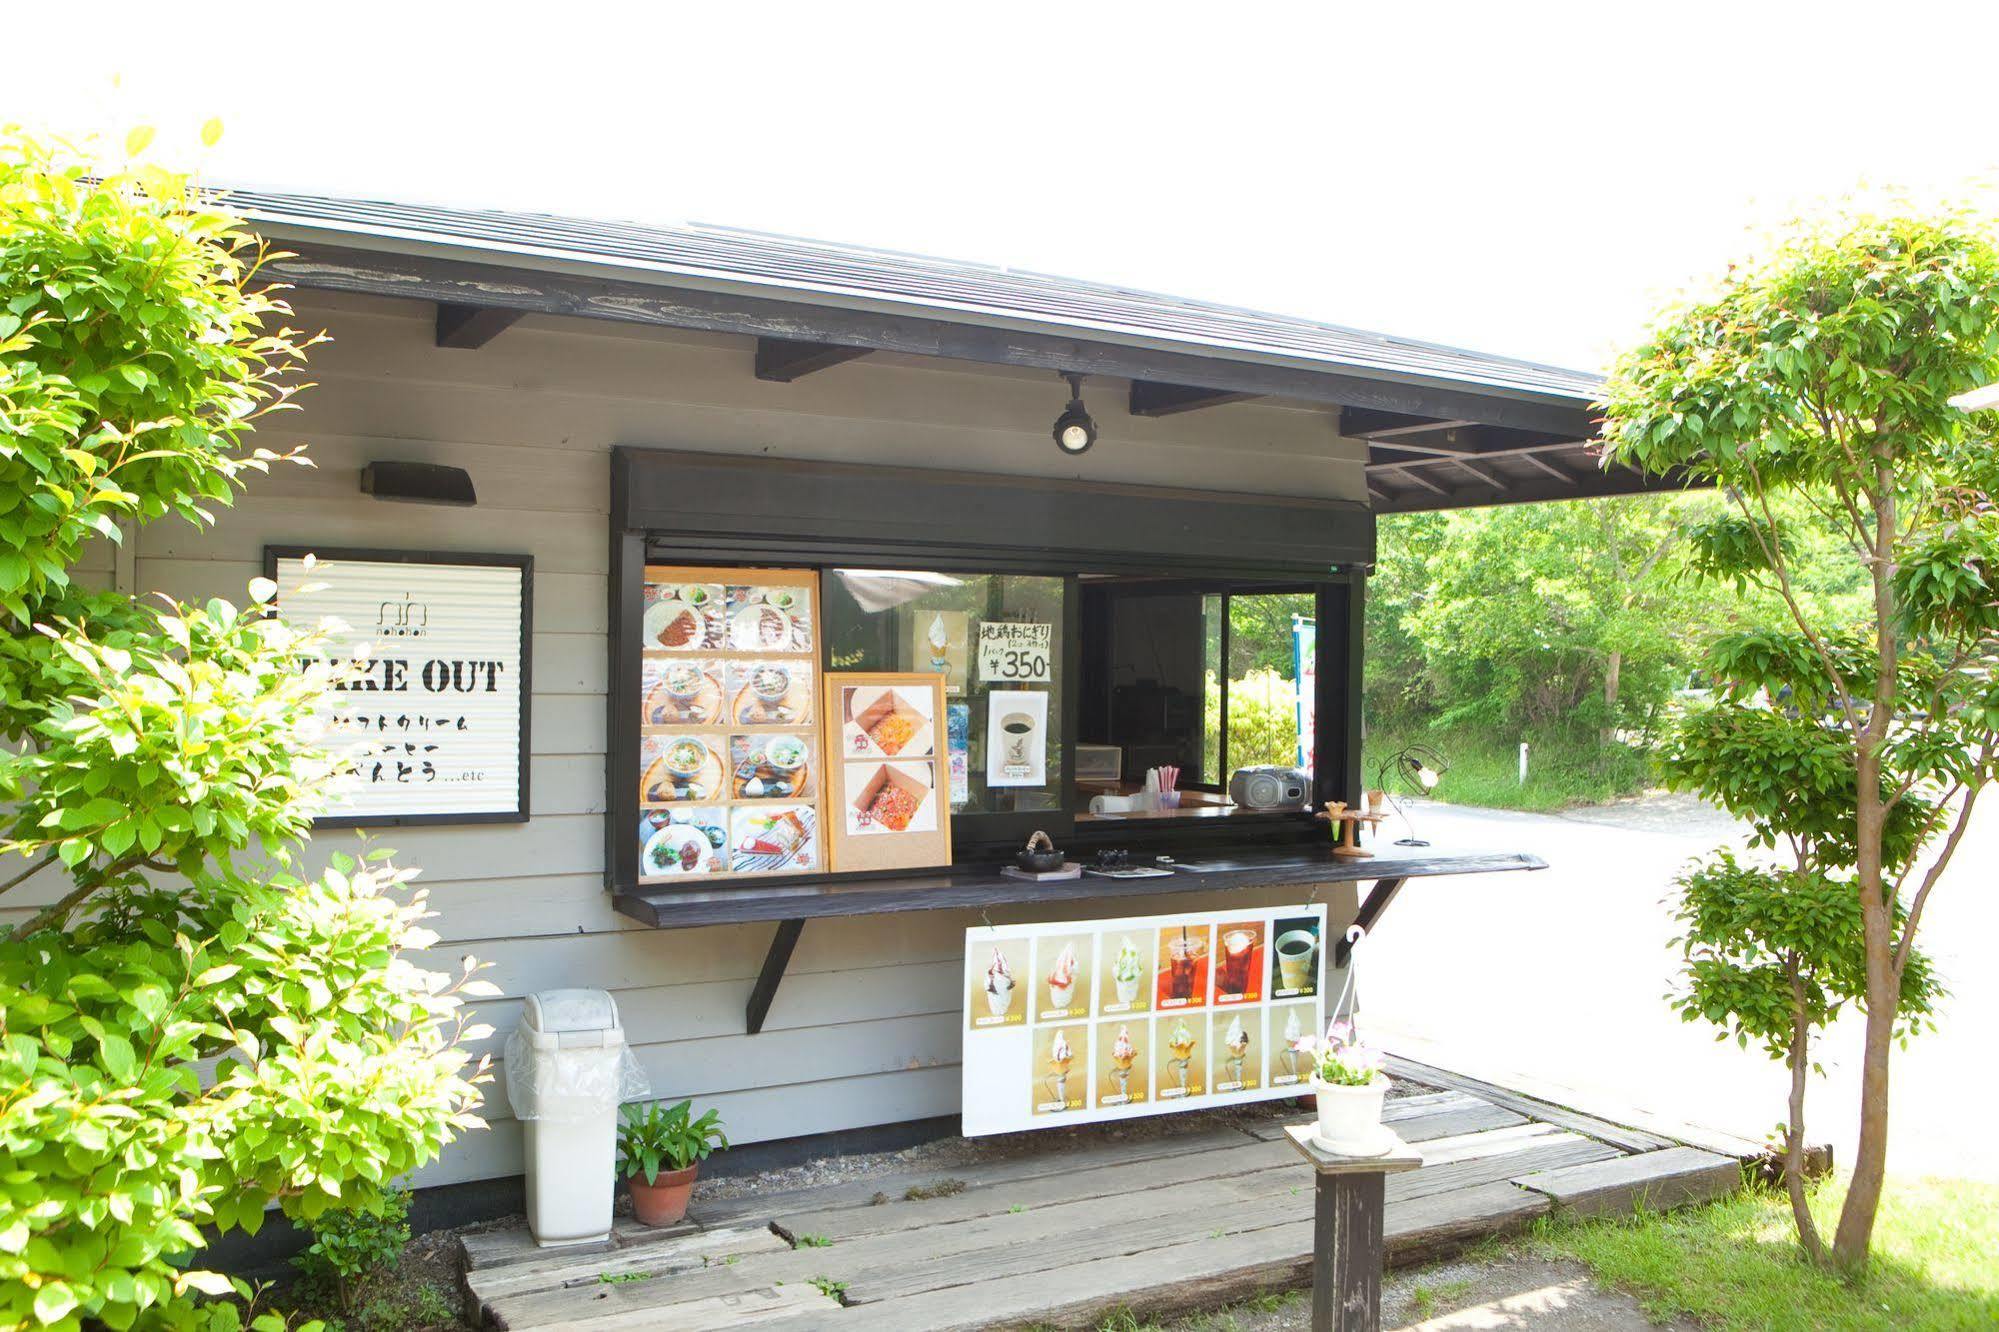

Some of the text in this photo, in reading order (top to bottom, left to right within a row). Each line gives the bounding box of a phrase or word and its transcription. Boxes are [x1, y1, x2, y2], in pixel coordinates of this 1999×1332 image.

[376, 626, 427, 636] nohohon
[422, 659, 504, 692] OUT
[362, 742, 439, 757] ーヒー
[326, 761, 436, 783] べんとう
